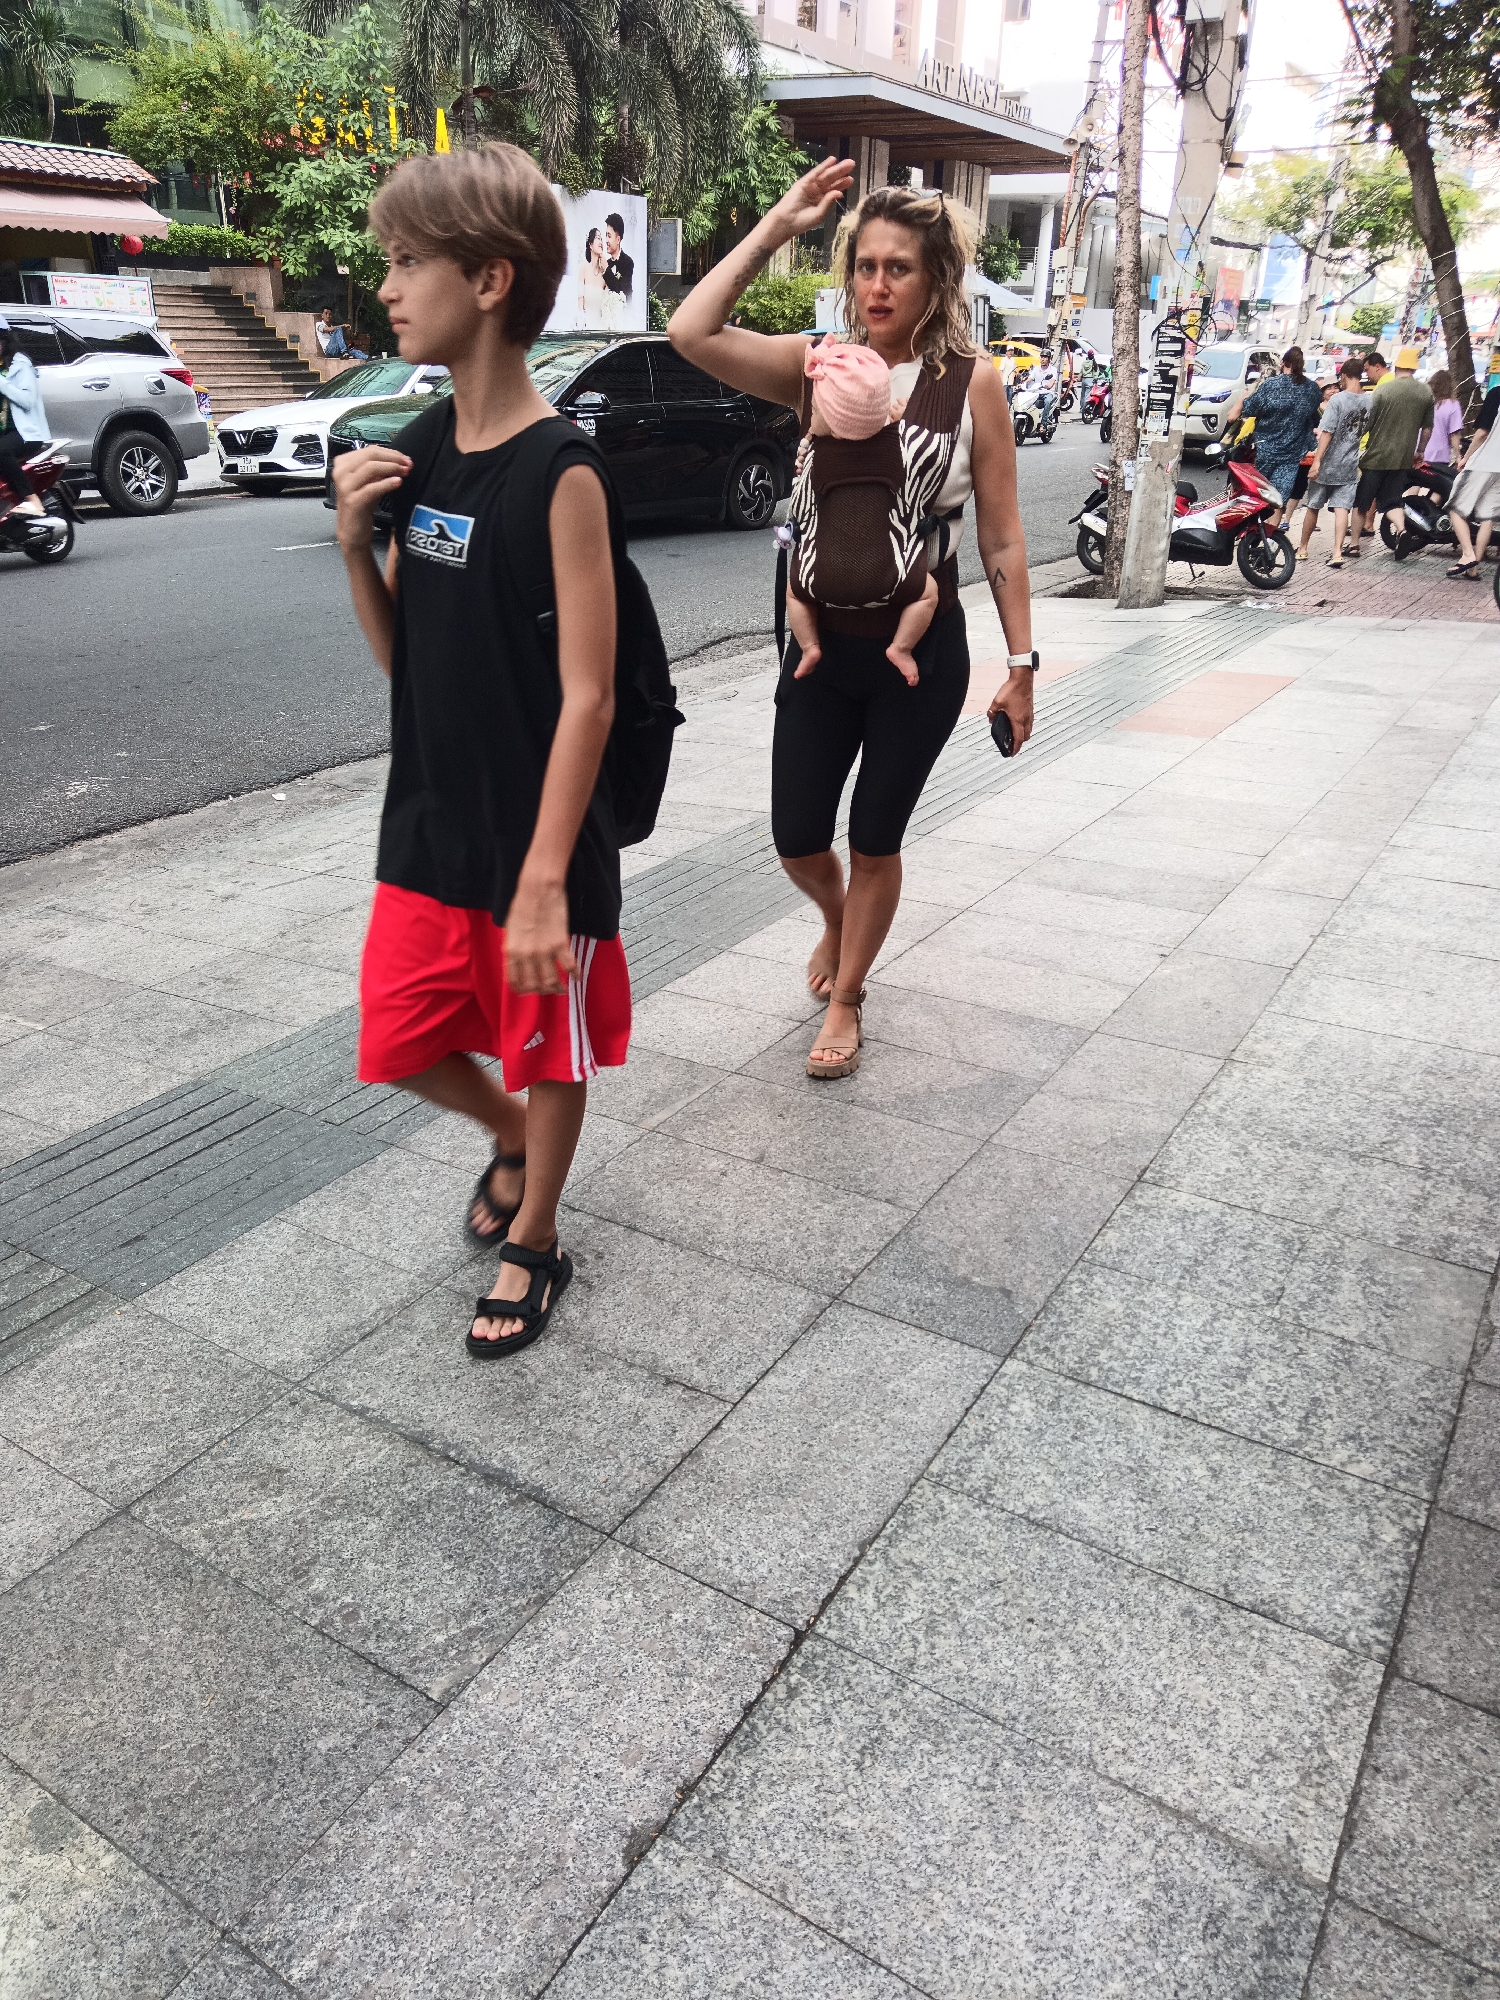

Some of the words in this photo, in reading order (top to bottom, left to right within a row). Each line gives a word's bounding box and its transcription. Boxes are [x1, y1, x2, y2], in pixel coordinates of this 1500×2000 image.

[915, 48, 955, 94] ART
[957, 62, 1005, 111] NEST
[1004, 98, 1033, 124] HOTEL
